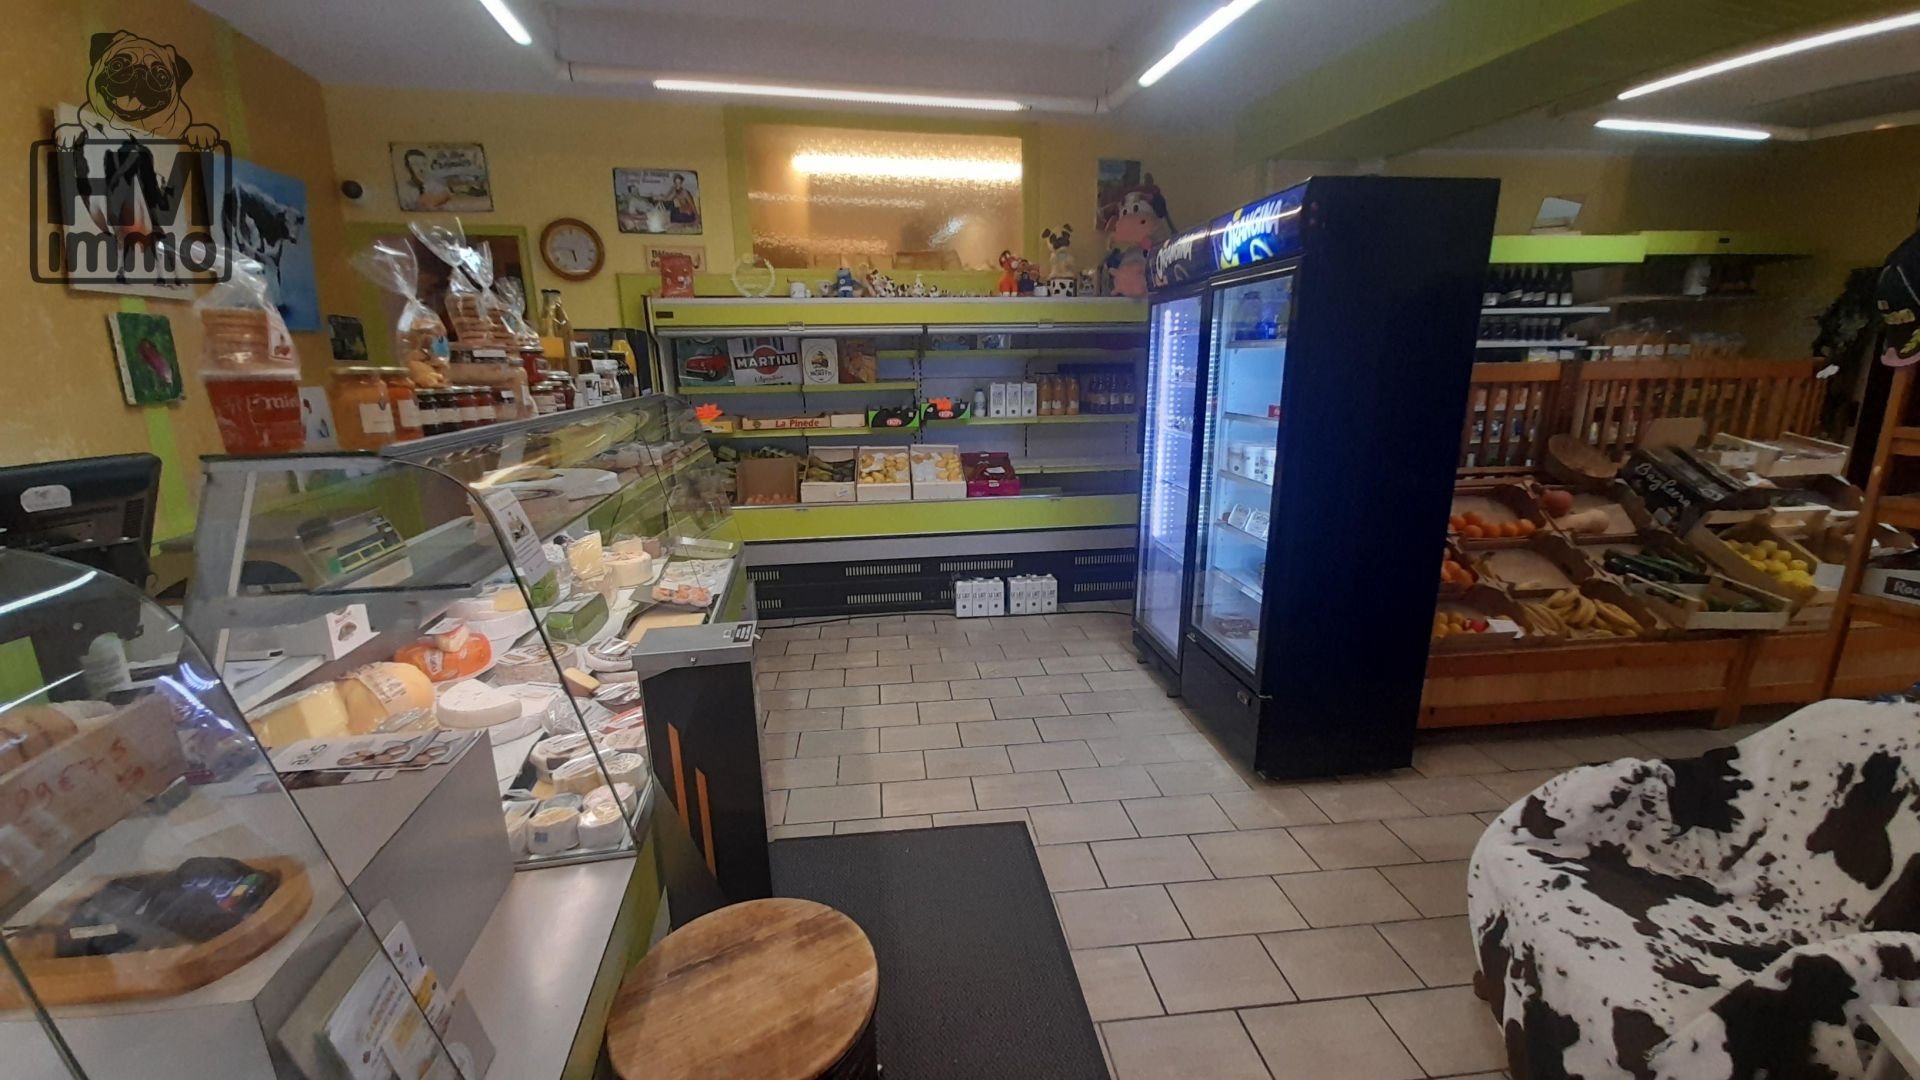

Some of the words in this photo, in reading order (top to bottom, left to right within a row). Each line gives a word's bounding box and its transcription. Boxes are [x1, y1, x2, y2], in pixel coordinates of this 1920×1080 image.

[1222, 199, 1283, 261] ORANGINA
[736, 354, 796, 369] MARTINI
[775, 420, 786, 428] La
